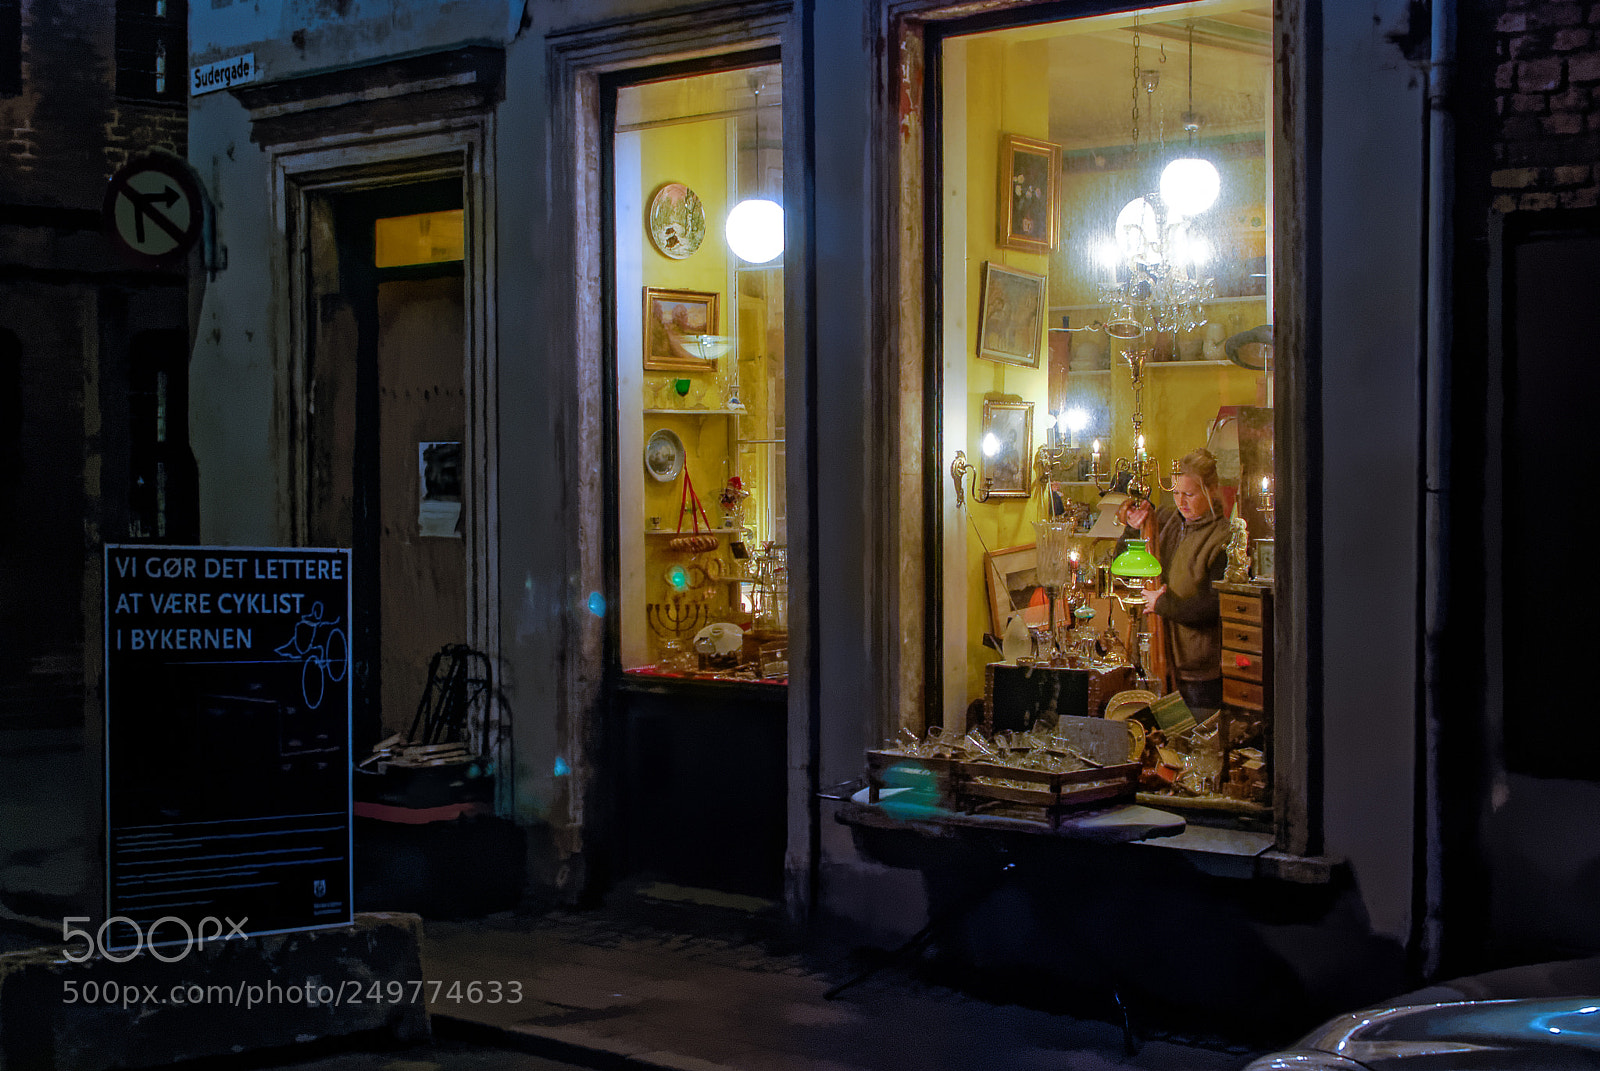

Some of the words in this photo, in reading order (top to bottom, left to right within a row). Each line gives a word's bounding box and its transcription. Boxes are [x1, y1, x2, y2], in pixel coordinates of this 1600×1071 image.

[195, 58, 249, 88] Sudergade
[115, 556, 137, 578] VI
[145, 557, 197, 578] GØR
[204, 558, 248, 579] DET
[254, 558, 343, 580] LETTERE
[115, 593, 143, 614] AT
[150, 593, 211, 614] VÆRE
[217, 593, 305, 614] CYKLIST
[116, 629, 122, 650] I
[131, 628, 252, 650] BYKERNEN
